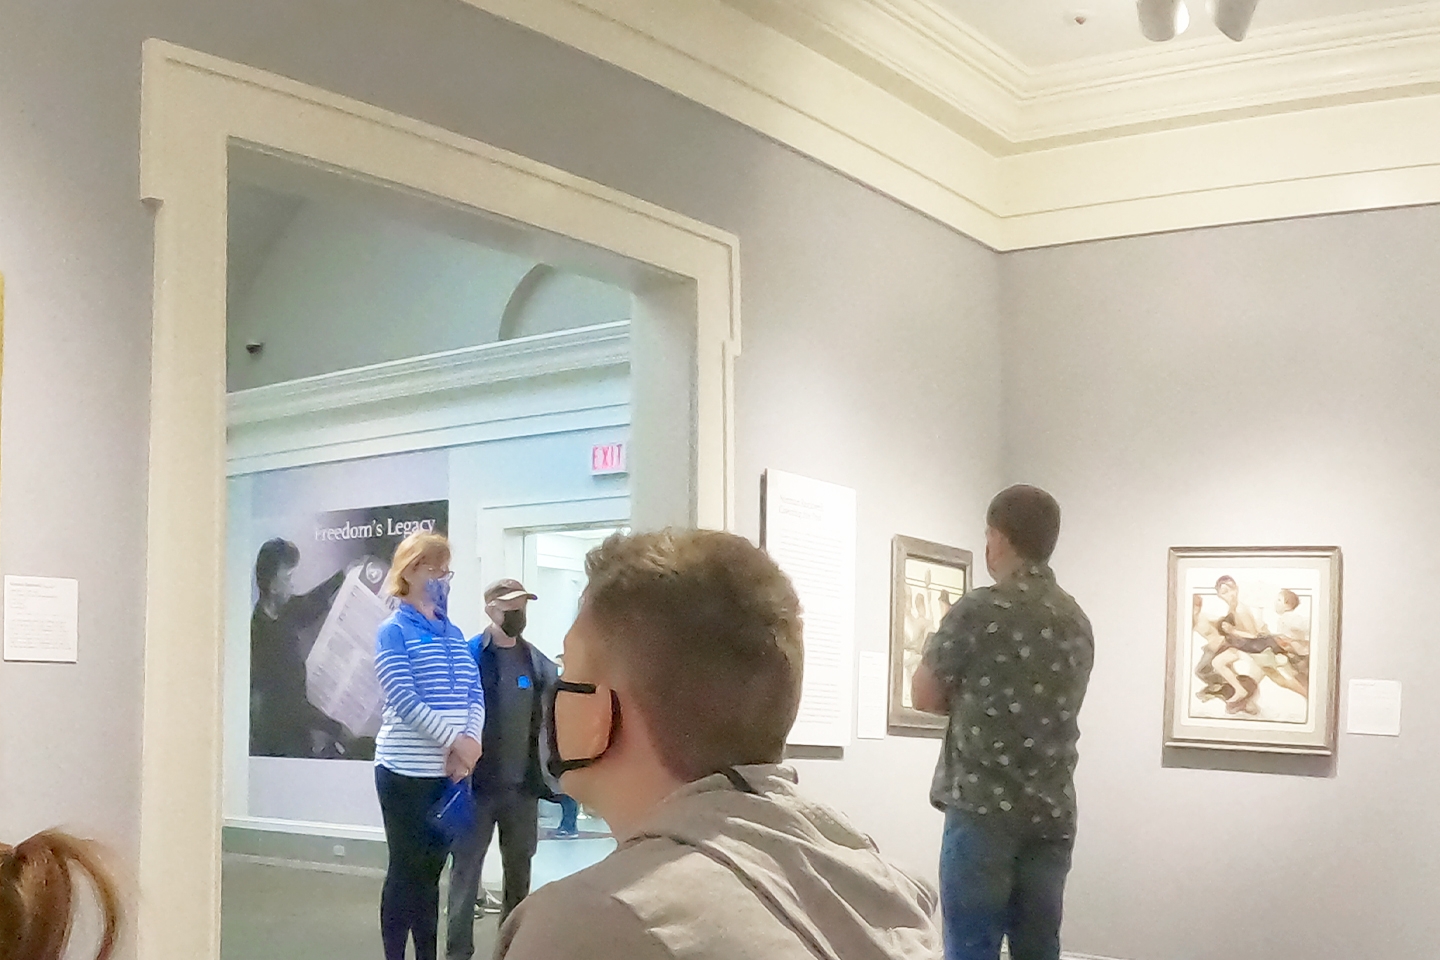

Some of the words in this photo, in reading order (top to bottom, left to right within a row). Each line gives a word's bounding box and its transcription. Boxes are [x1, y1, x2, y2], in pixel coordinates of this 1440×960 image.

[591, 443, 623, 470] EXIT
[315, 518, 383, 541] Freedom's
[387, 517, 436, 538] Legacy
